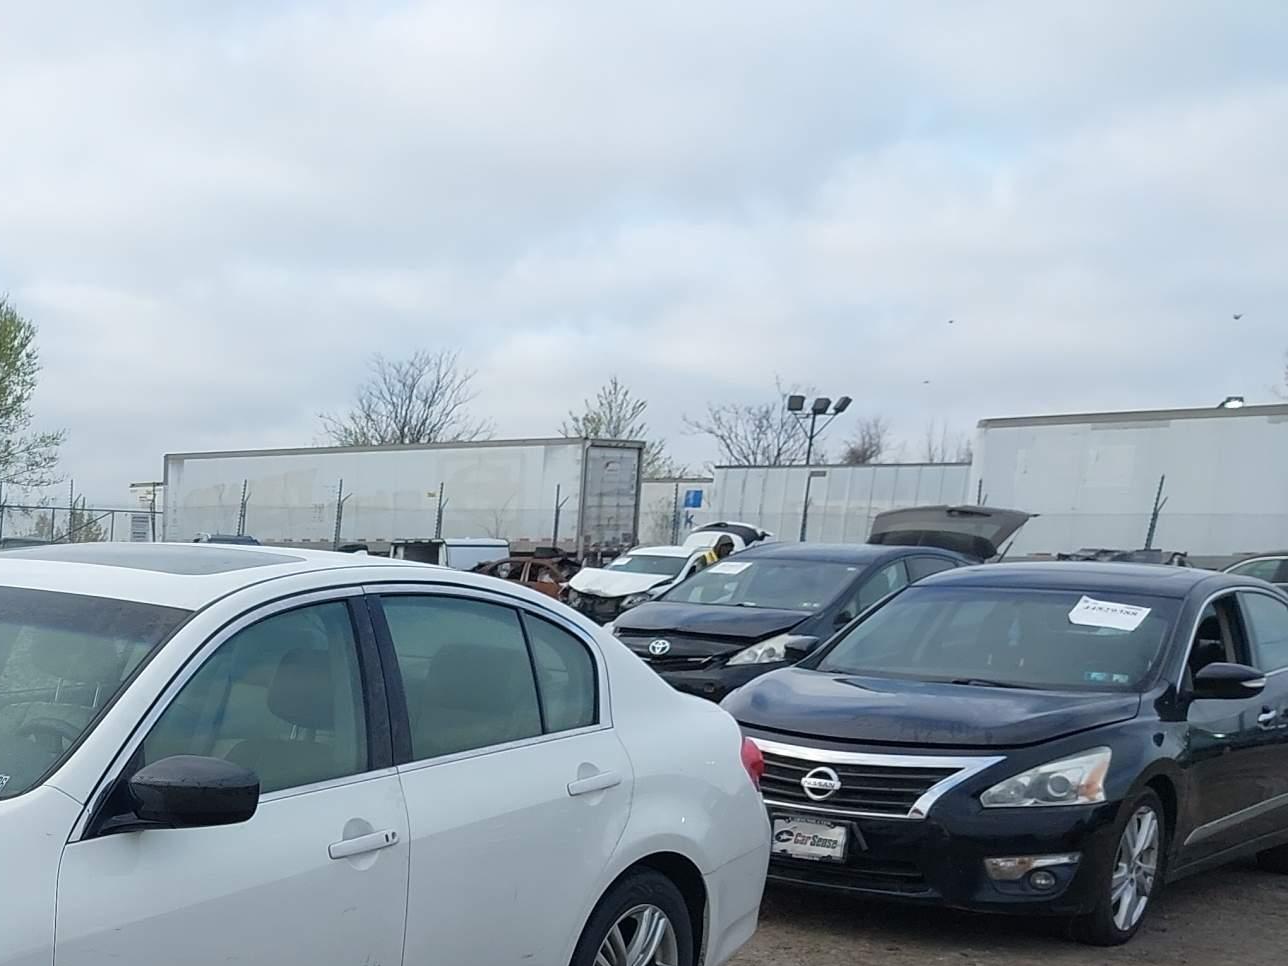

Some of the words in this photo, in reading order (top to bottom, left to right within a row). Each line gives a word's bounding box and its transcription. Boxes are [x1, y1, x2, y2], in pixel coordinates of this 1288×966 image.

[803, 779, 836, 789] NISSAN
[793, 832, 811, 846] Car
[810, 835, 838, 850] Sense
